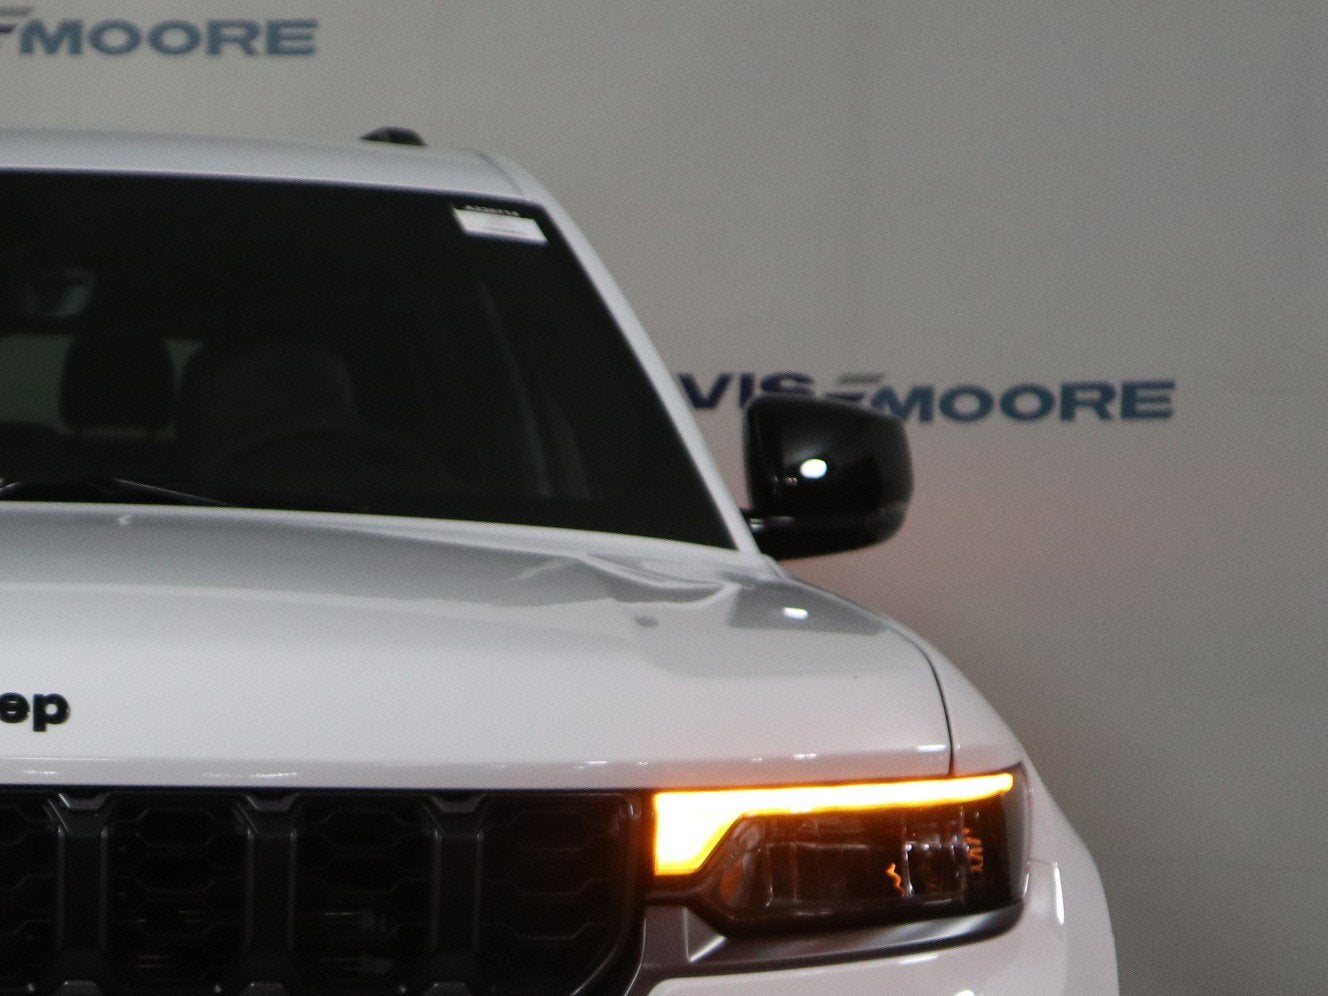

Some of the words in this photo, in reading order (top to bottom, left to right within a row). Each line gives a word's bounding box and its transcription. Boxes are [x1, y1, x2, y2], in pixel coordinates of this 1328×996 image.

[18, 18, 318, 57] MOORE
[676, 371, 816, 409] VIS
[871, 380, 1175, 424] MOORE
